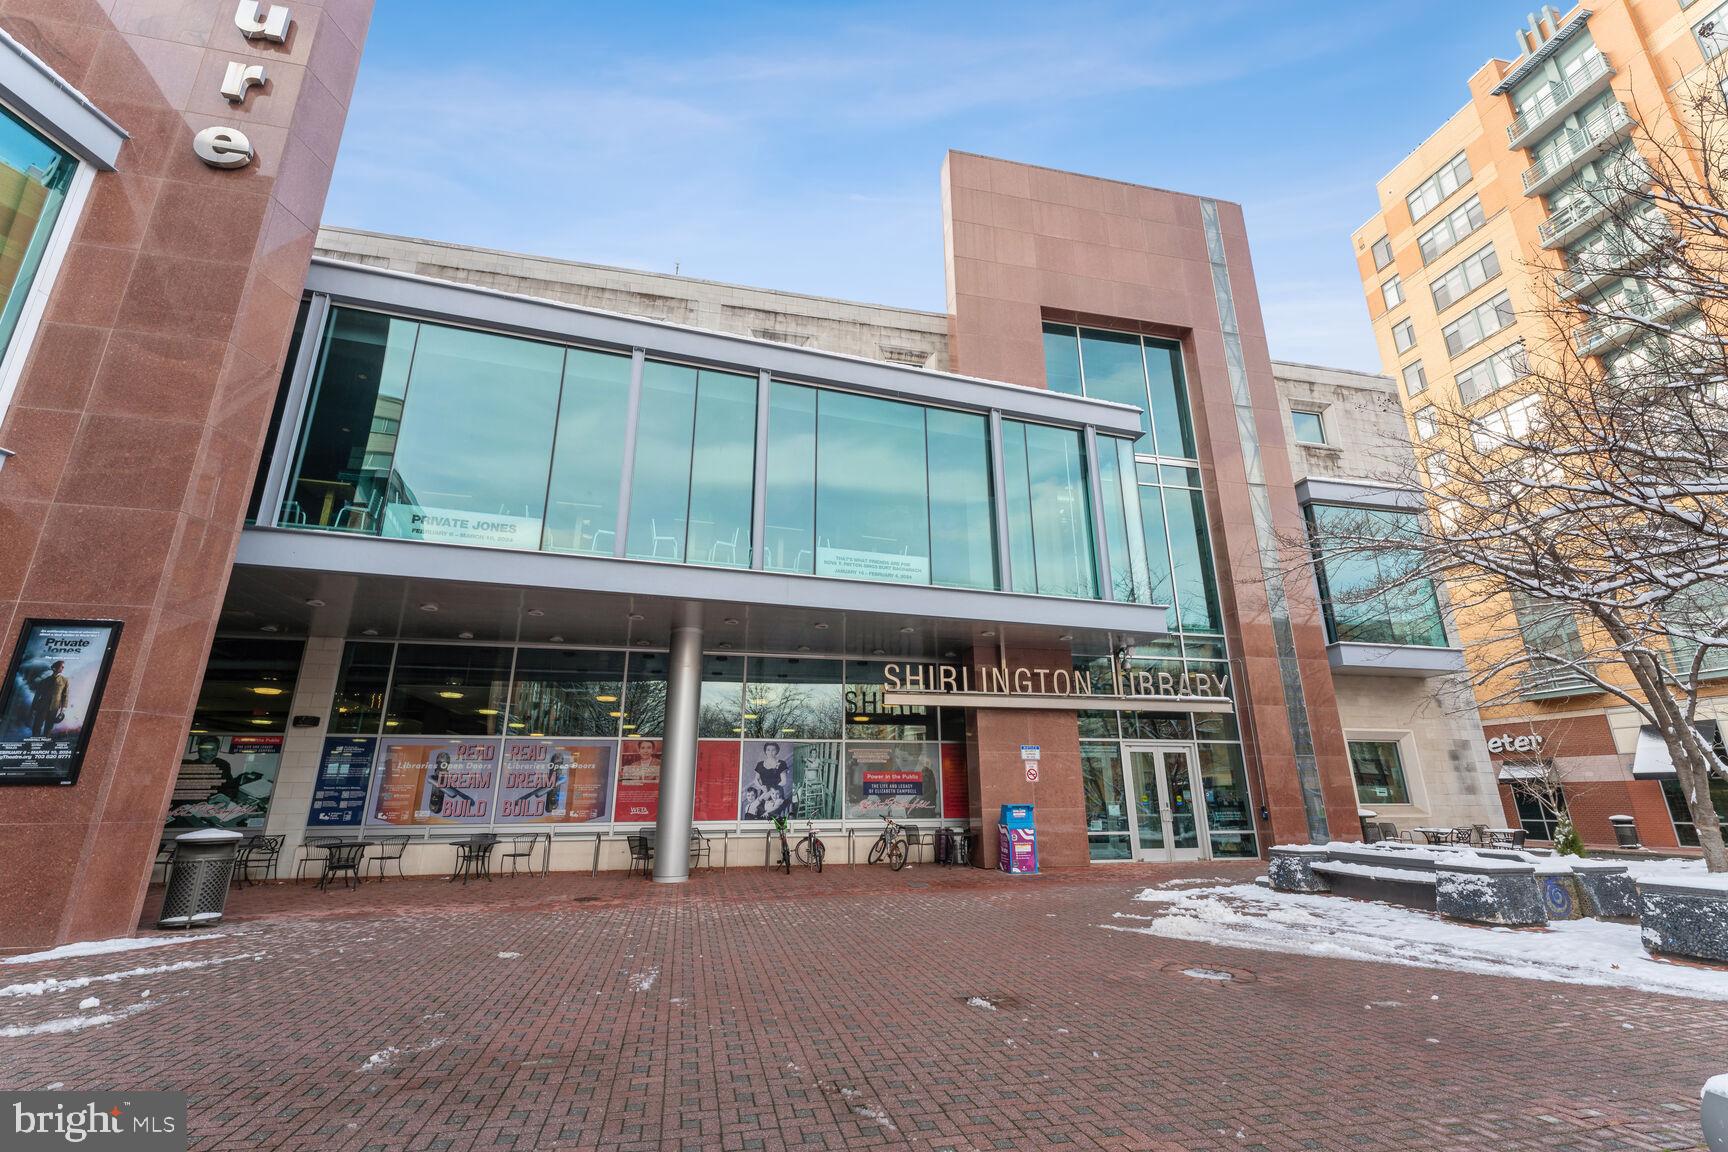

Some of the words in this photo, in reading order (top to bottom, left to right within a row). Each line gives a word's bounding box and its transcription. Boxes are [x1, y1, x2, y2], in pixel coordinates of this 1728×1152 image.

[411, 514, 470, 529] PRIVATE
[472, 521, 517, 534] JONES
[44, 646, 82, 654] Jones
[45, 638, 90, 647] Private
[884, 663, 1092, 697] SHIRLINGTON
[1112, 670, 1229, 698] LIBRARY
[456, 743, 496, 761] READ
[510, 743, 548, 761] READ
[1487, 733, 1543, 753] eter
[397, 761, 438, 770] Libraries
[440, 762, 464, 771] Open
[466, 762, 492, 770] Doors
[507, 762, 546, 770] Libraries
[436, 771, 492, 789] DREAM
[505, 771, 558, 789] DREAM
[442, 800, 488, 818] BUILD
[501, 799, 545, 817] BUILD
[630, 806, 649, 814] WETA
